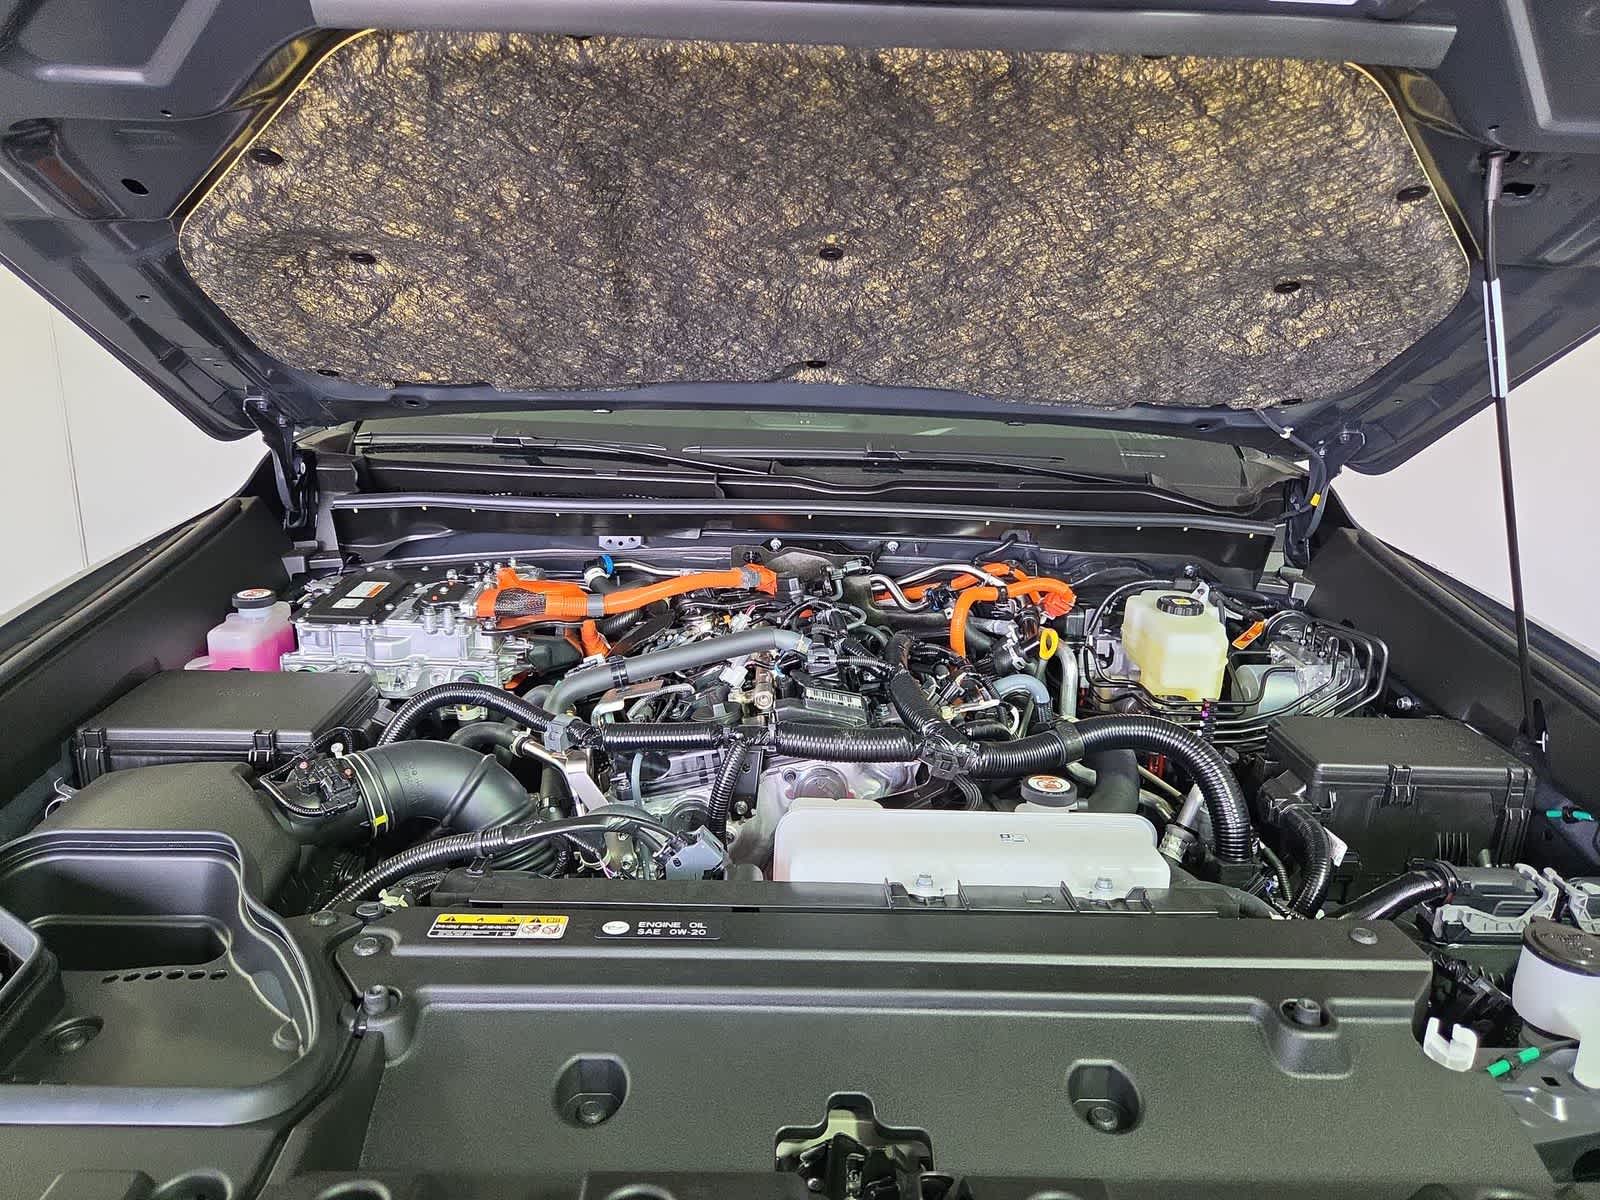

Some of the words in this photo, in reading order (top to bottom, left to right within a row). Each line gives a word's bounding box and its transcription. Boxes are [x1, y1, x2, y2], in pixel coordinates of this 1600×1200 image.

[638, 921, 682, 929] ENGINE
[689, 921, 708, 929] OIL
[637, 928, 662, 936] SAE
